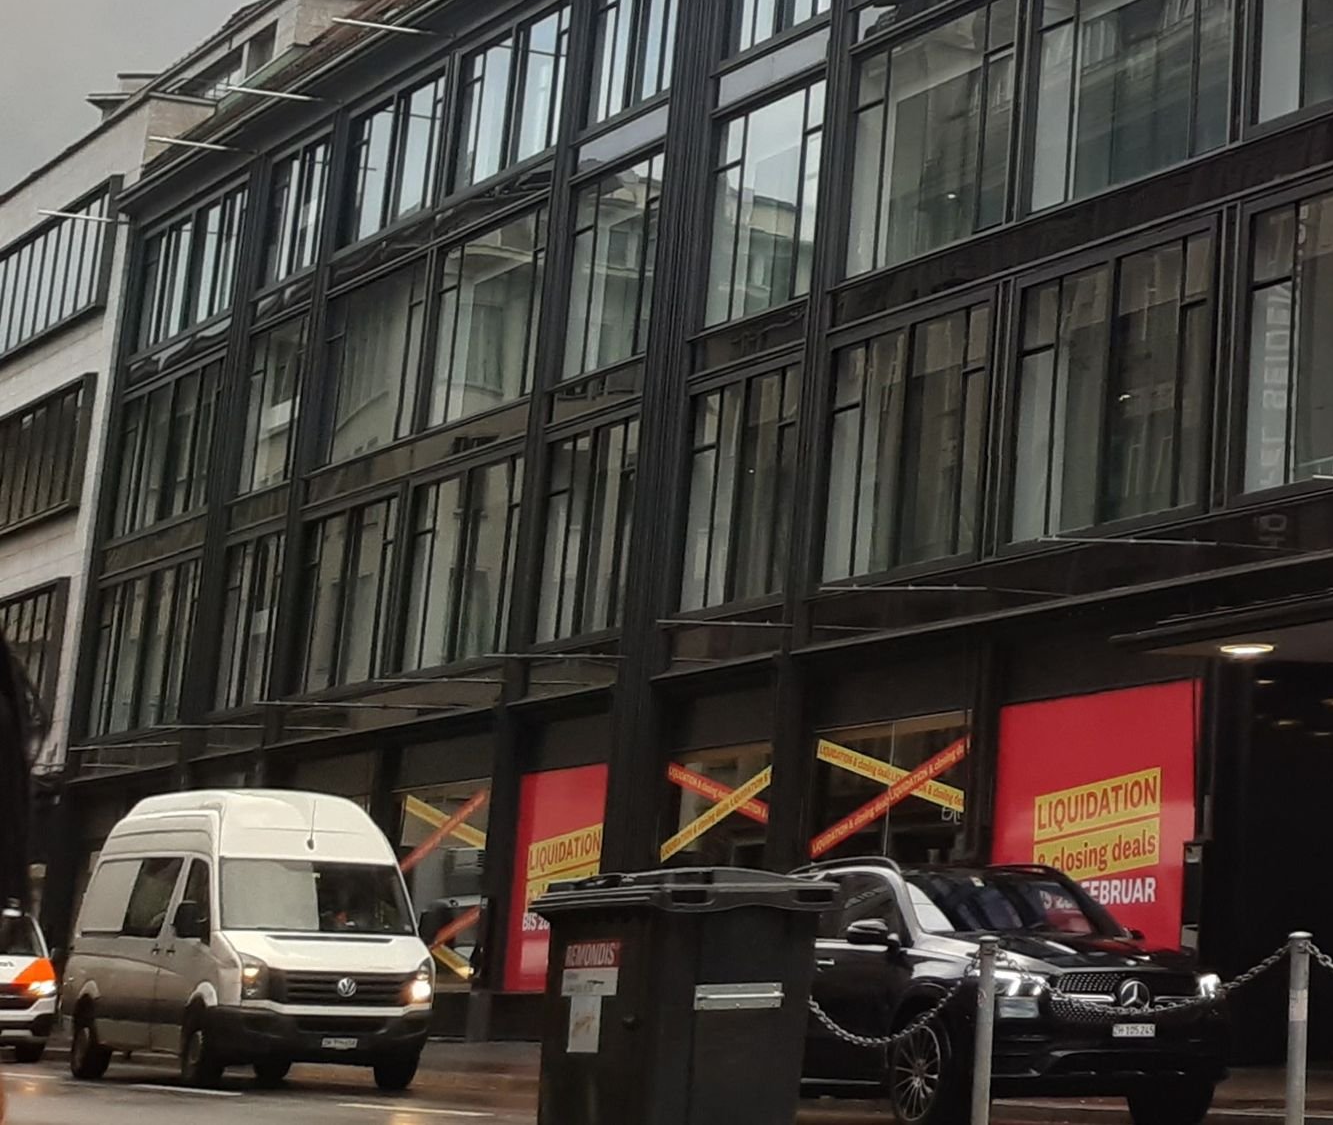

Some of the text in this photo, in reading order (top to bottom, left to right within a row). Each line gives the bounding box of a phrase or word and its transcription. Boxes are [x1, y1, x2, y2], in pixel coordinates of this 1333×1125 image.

[1038, 775, 1157, 832] LIQUIDATION
[529, 828, 601, 871] LIQUIDATION
[1052, 842, 1109, 872] closing
[1112, 829, 1156, 861] deals
[522, 912, 537, 932] BIS
